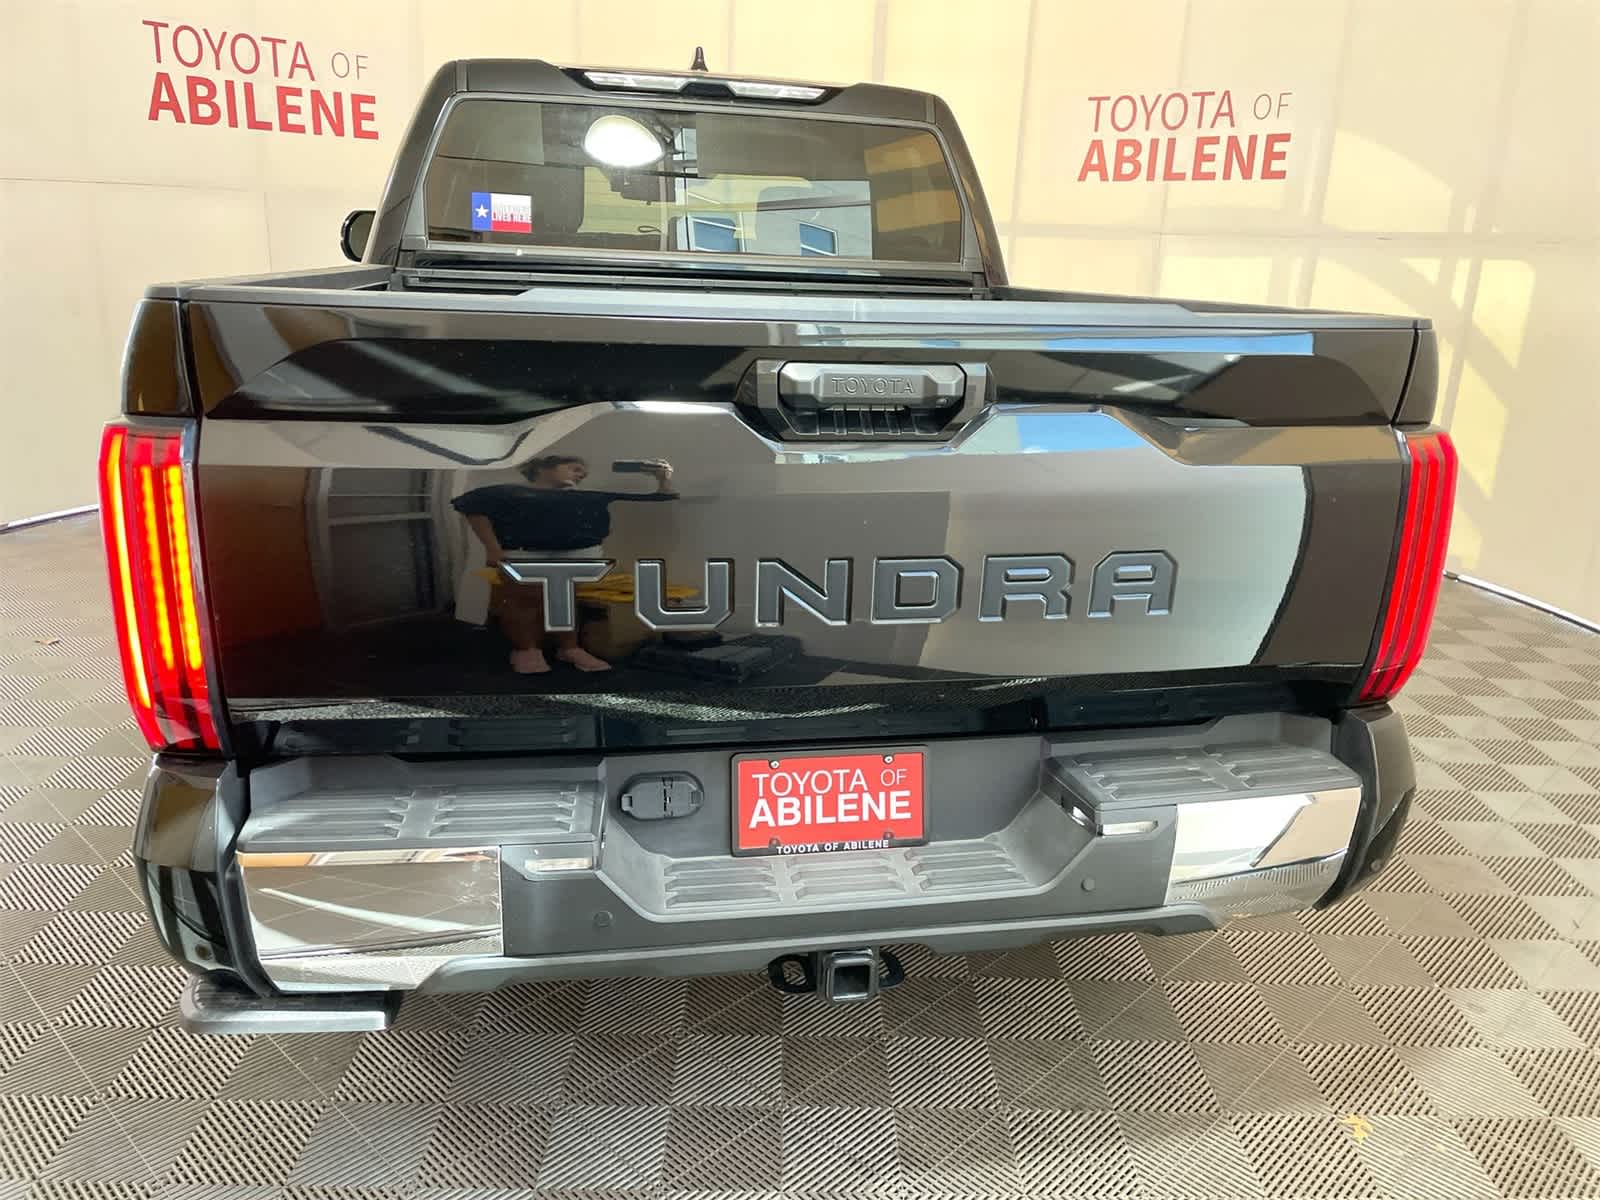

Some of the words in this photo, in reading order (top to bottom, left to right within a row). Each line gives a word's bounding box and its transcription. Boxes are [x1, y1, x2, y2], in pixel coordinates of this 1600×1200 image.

[142, 19, 315, 81] TOYOTA
[331, 51, 368, 79] OF
[148, 71, 379, 140] ABILENE
[1088, 90, 1235, 133] TOYOTA
[1253, 92, 1293, 120] OF
[1077, 133, 1292, 182] ABILENE
[831, 377, 916, 395] TOYOTA
[502, 550, 1177, 632] TUNDRA
[752, 769, 868, 797] TOYOTA
[880, 768, 908, 787] OF
[749, 790, 912, 829] ABILENE
[777, 844, 819, 855] TOYOTA
[824, 843, 838, 851] OF
[844, 839, 889, 850] ABILENE
